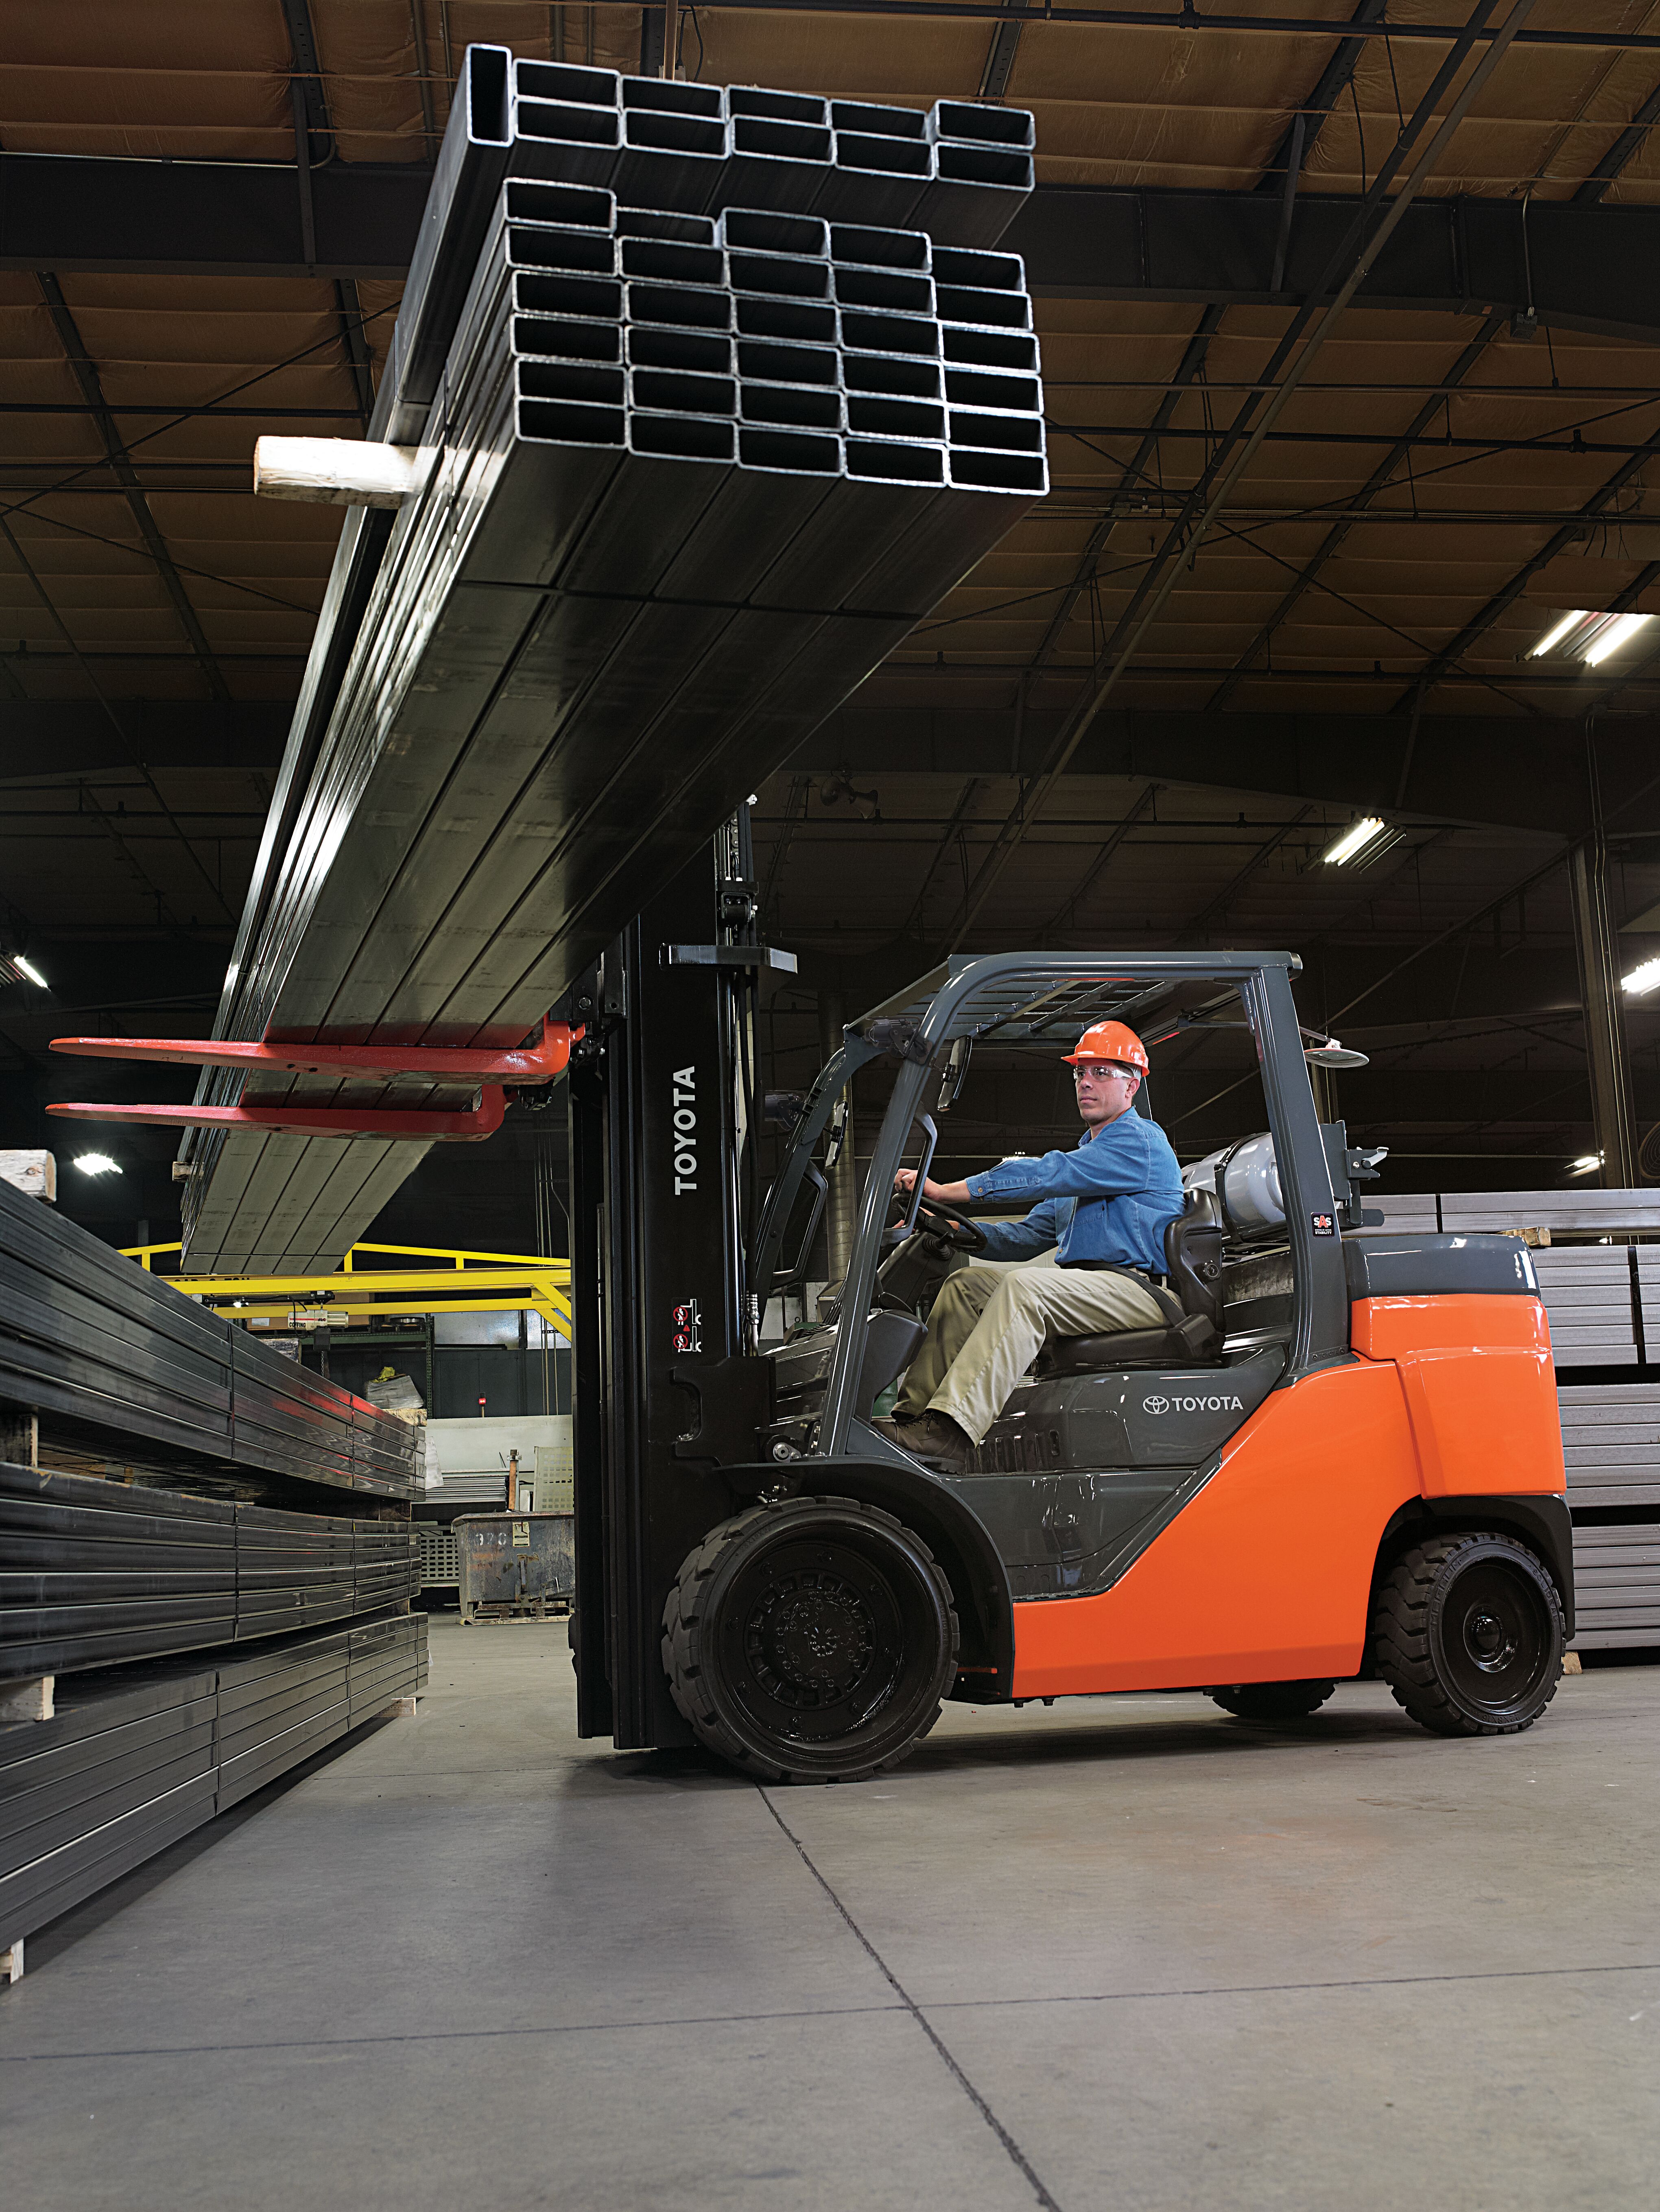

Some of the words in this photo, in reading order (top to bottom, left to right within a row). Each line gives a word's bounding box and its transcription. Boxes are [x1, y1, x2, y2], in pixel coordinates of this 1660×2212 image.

[673, 1066, 697, 1195] TOYOTA
[1313, 1215, 1332, 1228] SAS
[1319, 1350, 1339, 1358] TOYOTA
[1171, 1396, 1243, 1411] TOYOTA
[1533, 1568, 1559, 1622] SOLIDEAL
